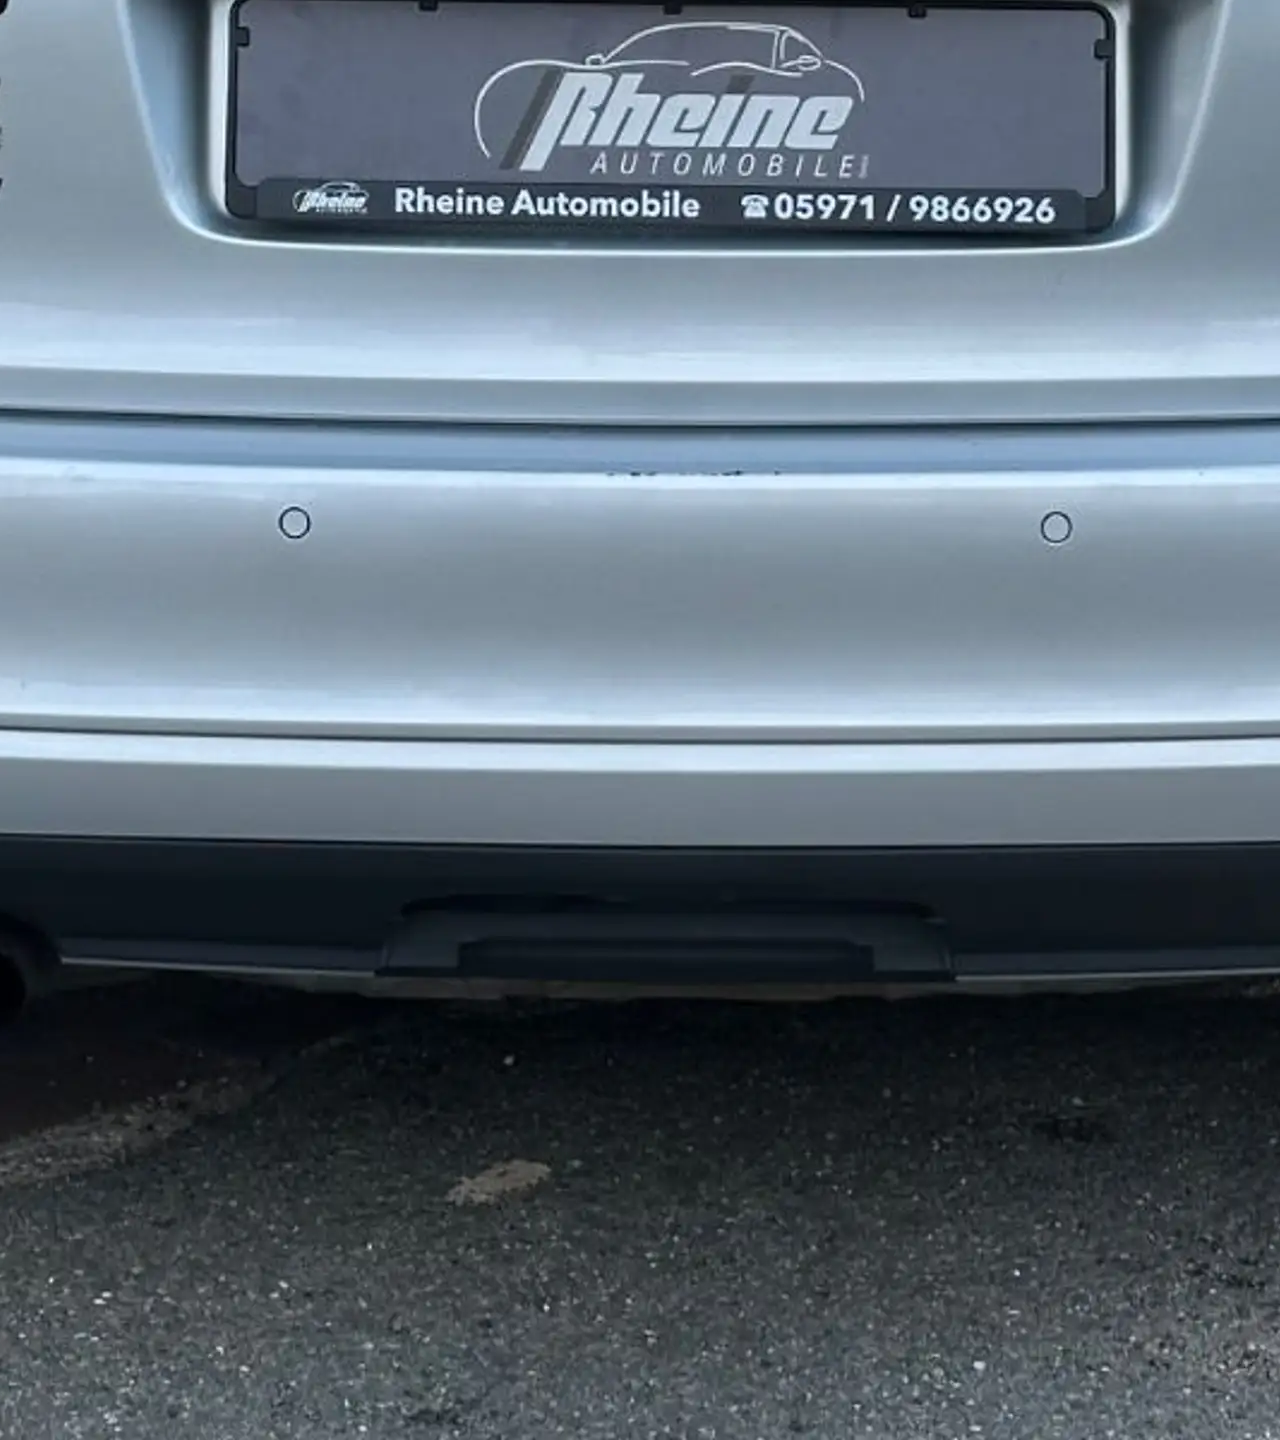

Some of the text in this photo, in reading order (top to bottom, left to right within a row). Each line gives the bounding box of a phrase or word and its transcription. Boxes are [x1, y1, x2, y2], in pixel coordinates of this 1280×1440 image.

[520, 72, 854, 172] Rheine
[394, 186, 505, 215] Rheine
[510, 188, 700, 218] Automobile
[774, 192, 875, 220] 05971
[908, 194, 1056, 224] 9866926
